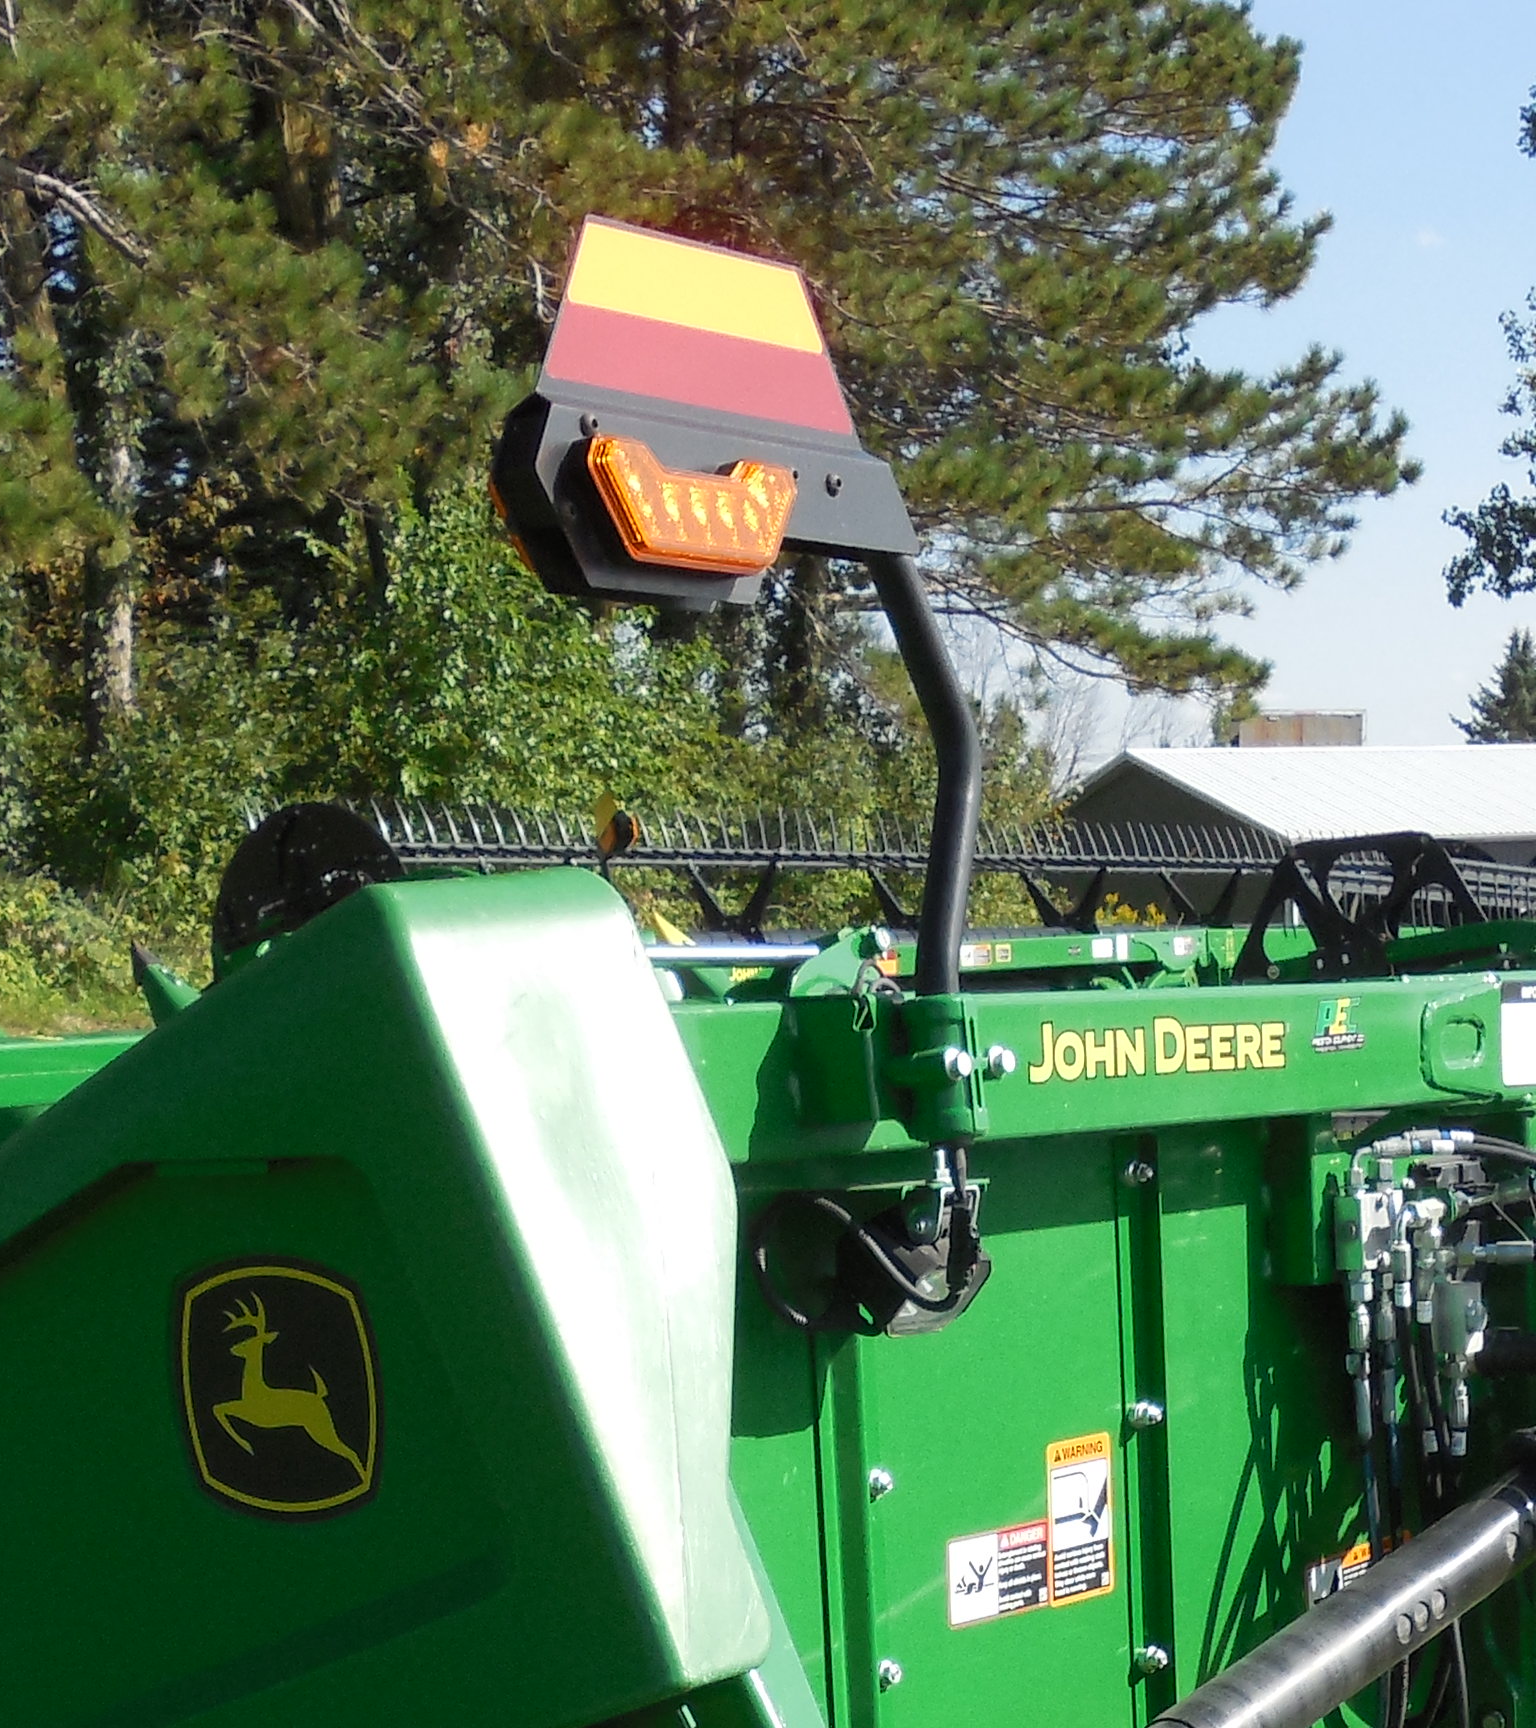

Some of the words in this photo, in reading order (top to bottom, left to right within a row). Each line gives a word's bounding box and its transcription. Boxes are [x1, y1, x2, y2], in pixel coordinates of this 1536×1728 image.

[1028, 1020, 1147, 1084] JOHN
[1153, 1016, 1286, 1075] DEERE
[1062, 1440, 1104, 1461] WARNING
[1009, 1526, 1045, 1546] DANGER
